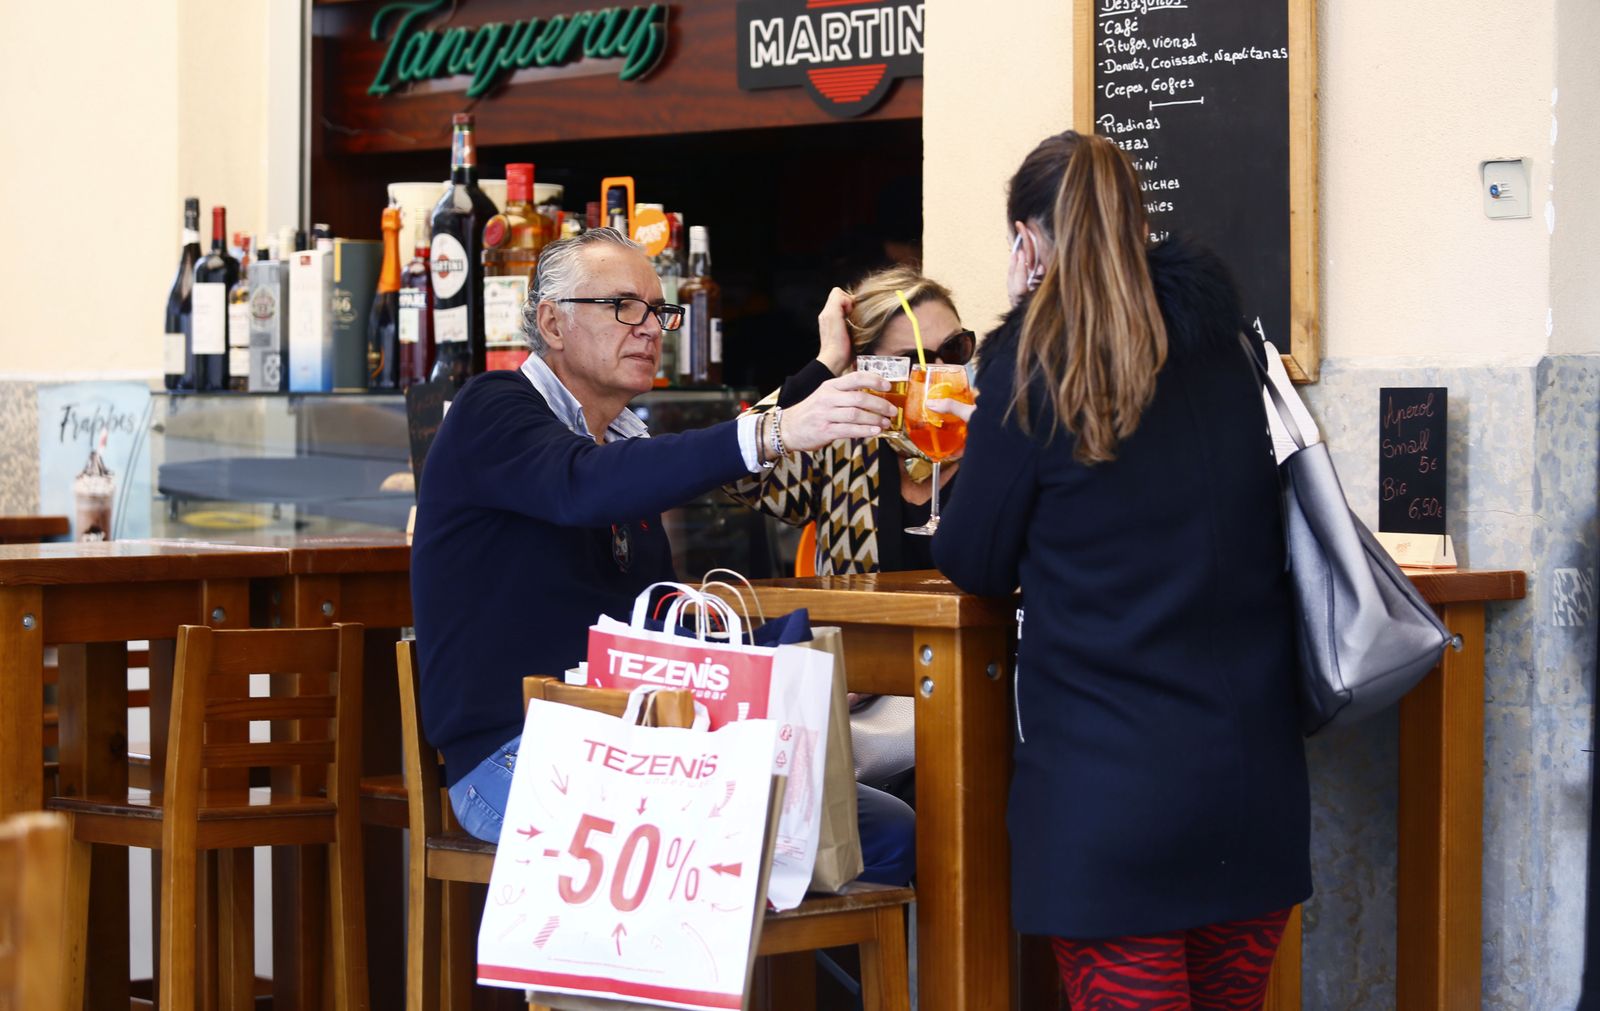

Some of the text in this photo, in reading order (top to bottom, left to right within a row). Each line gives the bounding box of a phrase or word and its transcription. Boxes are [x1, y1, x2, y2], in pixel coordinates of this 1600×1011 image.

[1100, 0, 1186, 14] Desayunos
[367, 0, 660, 97] Tanqueray
[750, 4, 925, 68] MARTIN
[1384, 392, 1434, 437] Aperol
[1383, 428, 1430, 458] Small
